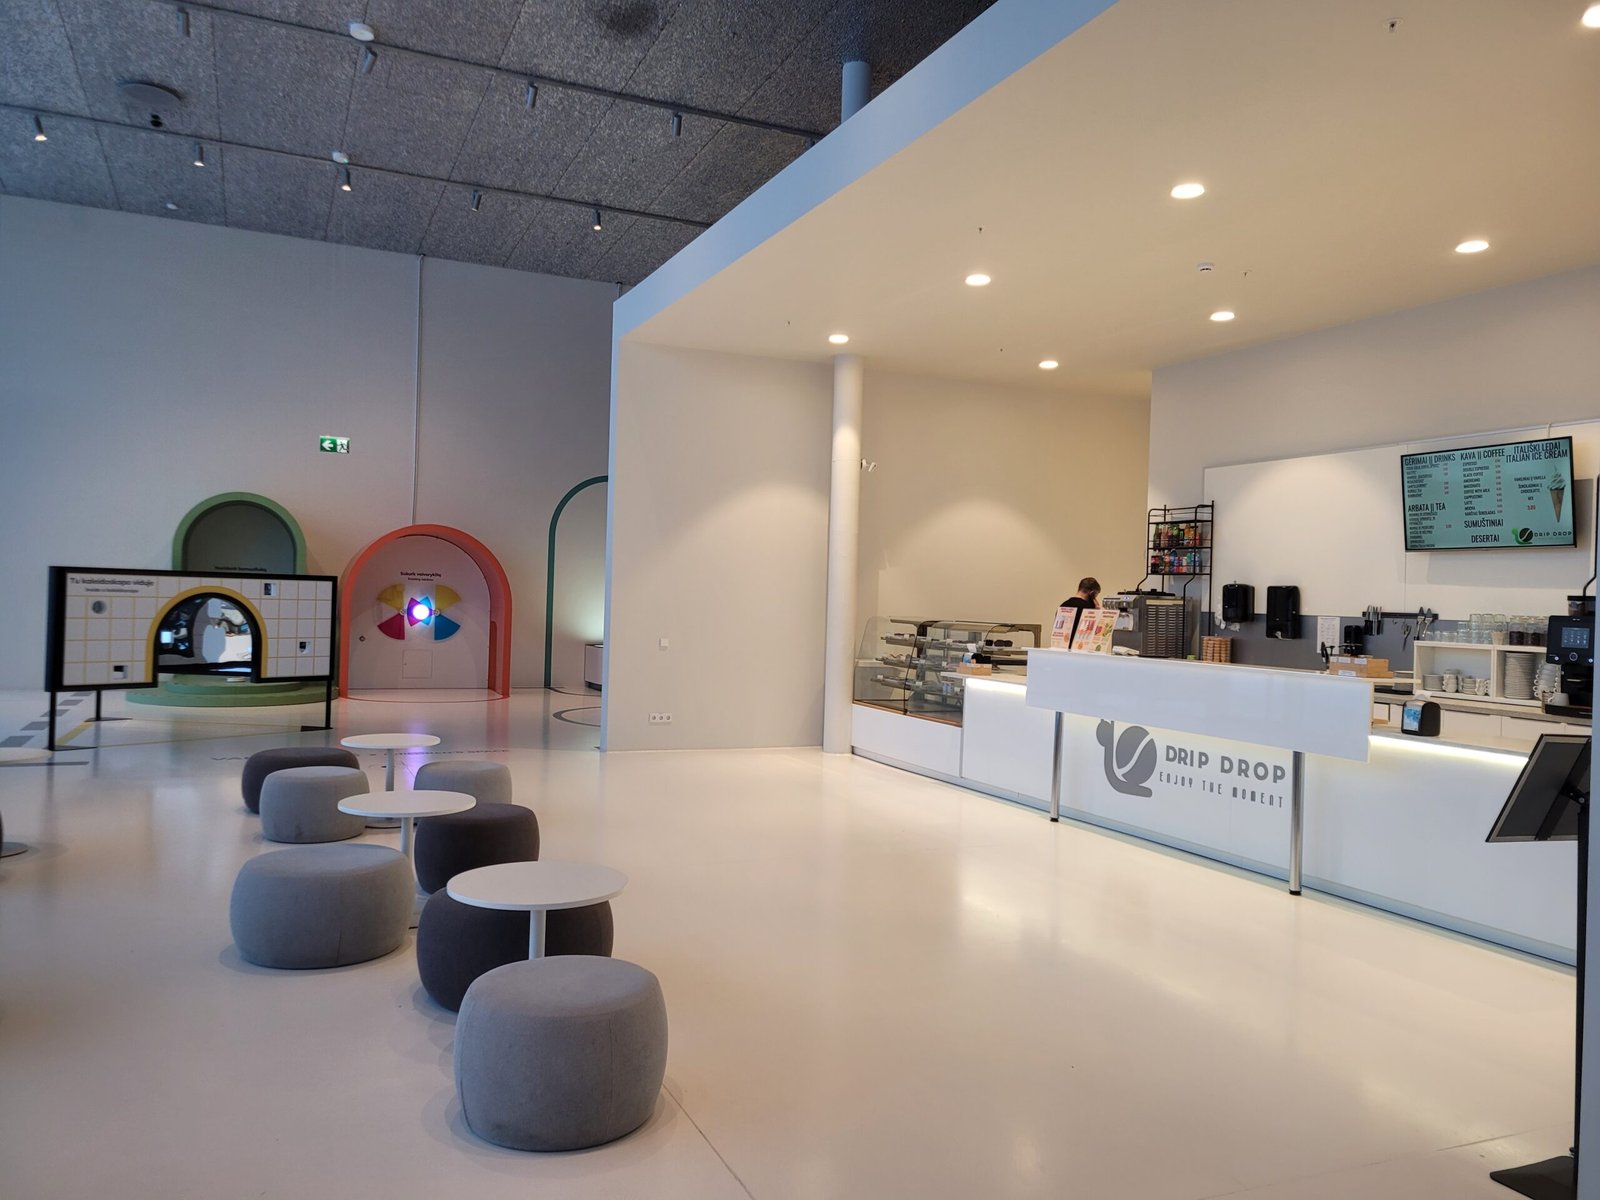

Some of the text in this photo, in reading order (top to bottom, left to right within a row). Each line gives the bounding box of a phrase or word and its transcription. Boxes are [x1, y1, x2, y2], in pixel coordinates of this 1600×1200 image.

[1460, 451, 1476, 461] KAVA
[1483, 448, 1505, 458] COFFEE
[1513, 441, 1561, 455] ITALIŠKI LEDAI
[1434, 453, 1456, 463] DRINKS
[1506, 449, 1568, 463] ITALIAN ICE CREAM
[1408, 504, 1429, 513] ARBATA
[1436, 502, 1447, 511] TEA
[1464, 517, 1504, 528] SUMUŠTINIAI
[1471, 534, 1500, 543] DESERTAI
[1165, 745, 1286, 783] DRIP DROP
[1159, 771, 1284, 809] ENJOY THE MOMENT
